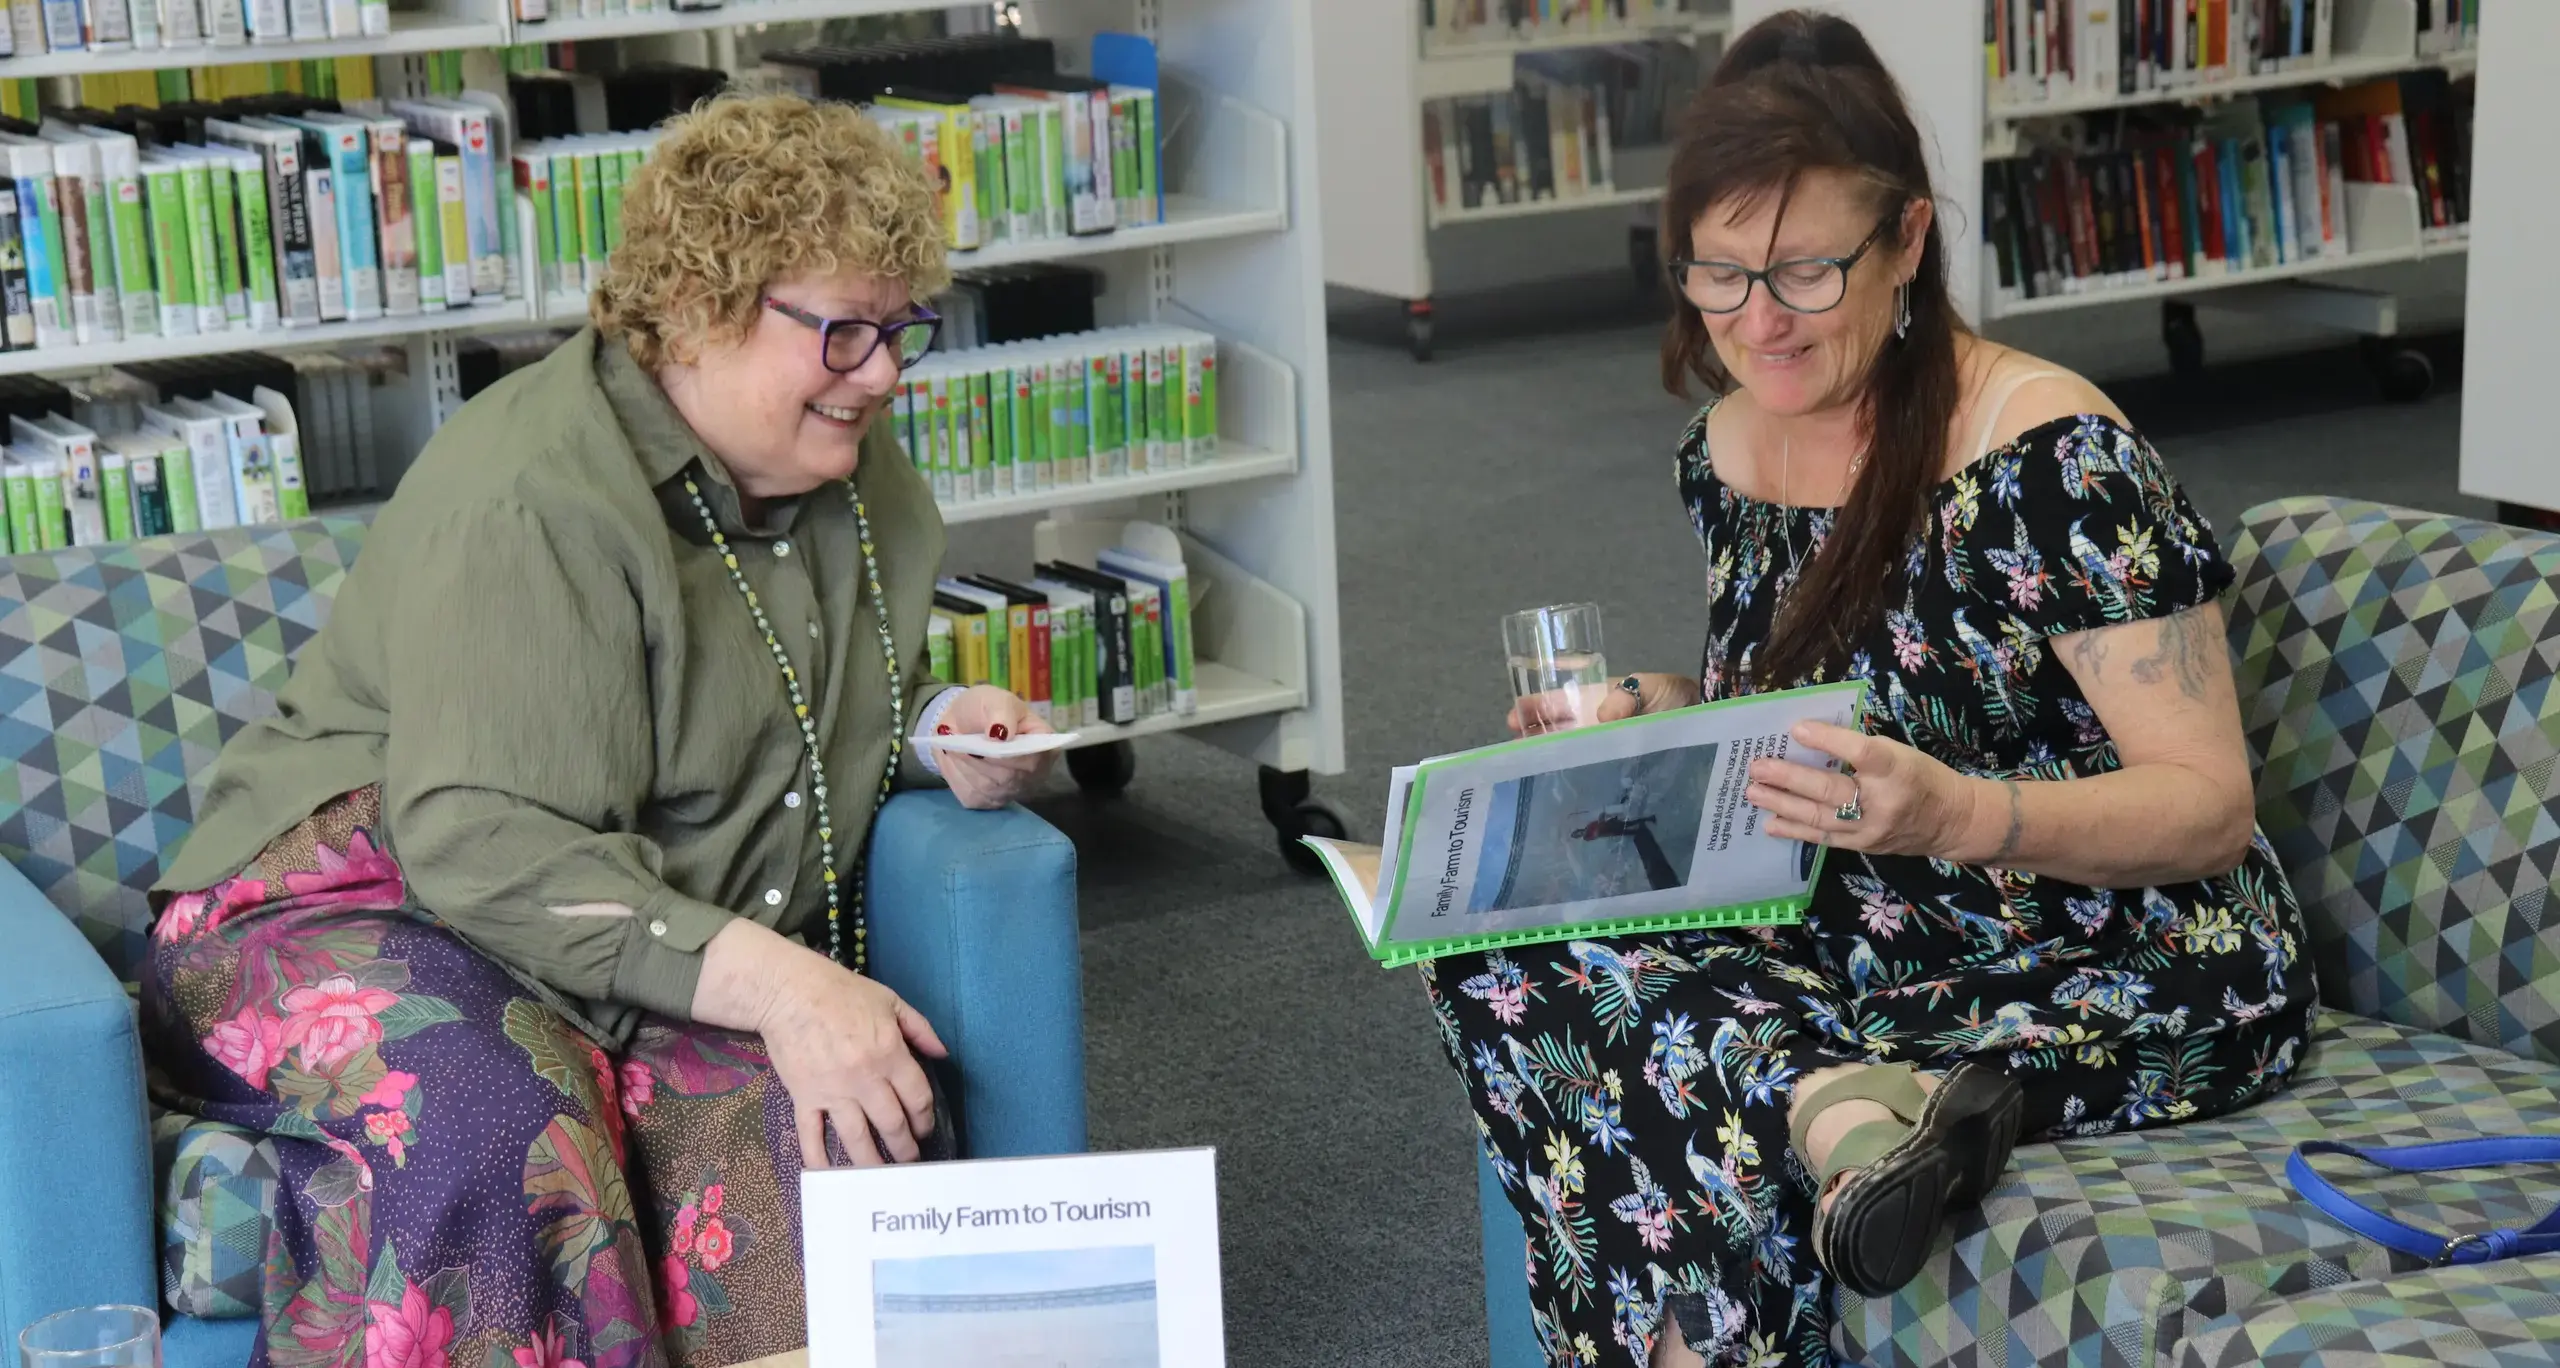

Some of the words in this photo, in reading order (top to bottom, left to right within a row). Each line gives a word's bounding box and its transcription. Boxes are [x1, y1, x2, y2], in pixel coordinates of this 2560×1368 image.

[1731, 739, 1740, 754] and
[1766, 733, 1777, 752] Dish
[1725, 753, 1738, 776] music
[1726, 791, 1740, 814] house
[1736, 766, 1747, 778] can
[1449, 788, 1474, 840] Tourism
[1711, 812, 1723, 823] full
[1447, 839, 1464, 853] to
[1706, 823, 1720, 846] house
[1440, 852, 1462, 885] Farm
[1430, 885, 1459, 918] Family
[871, 1206, 953, 1235] Family
[956, 1205, 1019, 1228] Farm
[1022, 1203, 1048, 1225] to
[1049, 1197, 1151, 1222] Tourism
